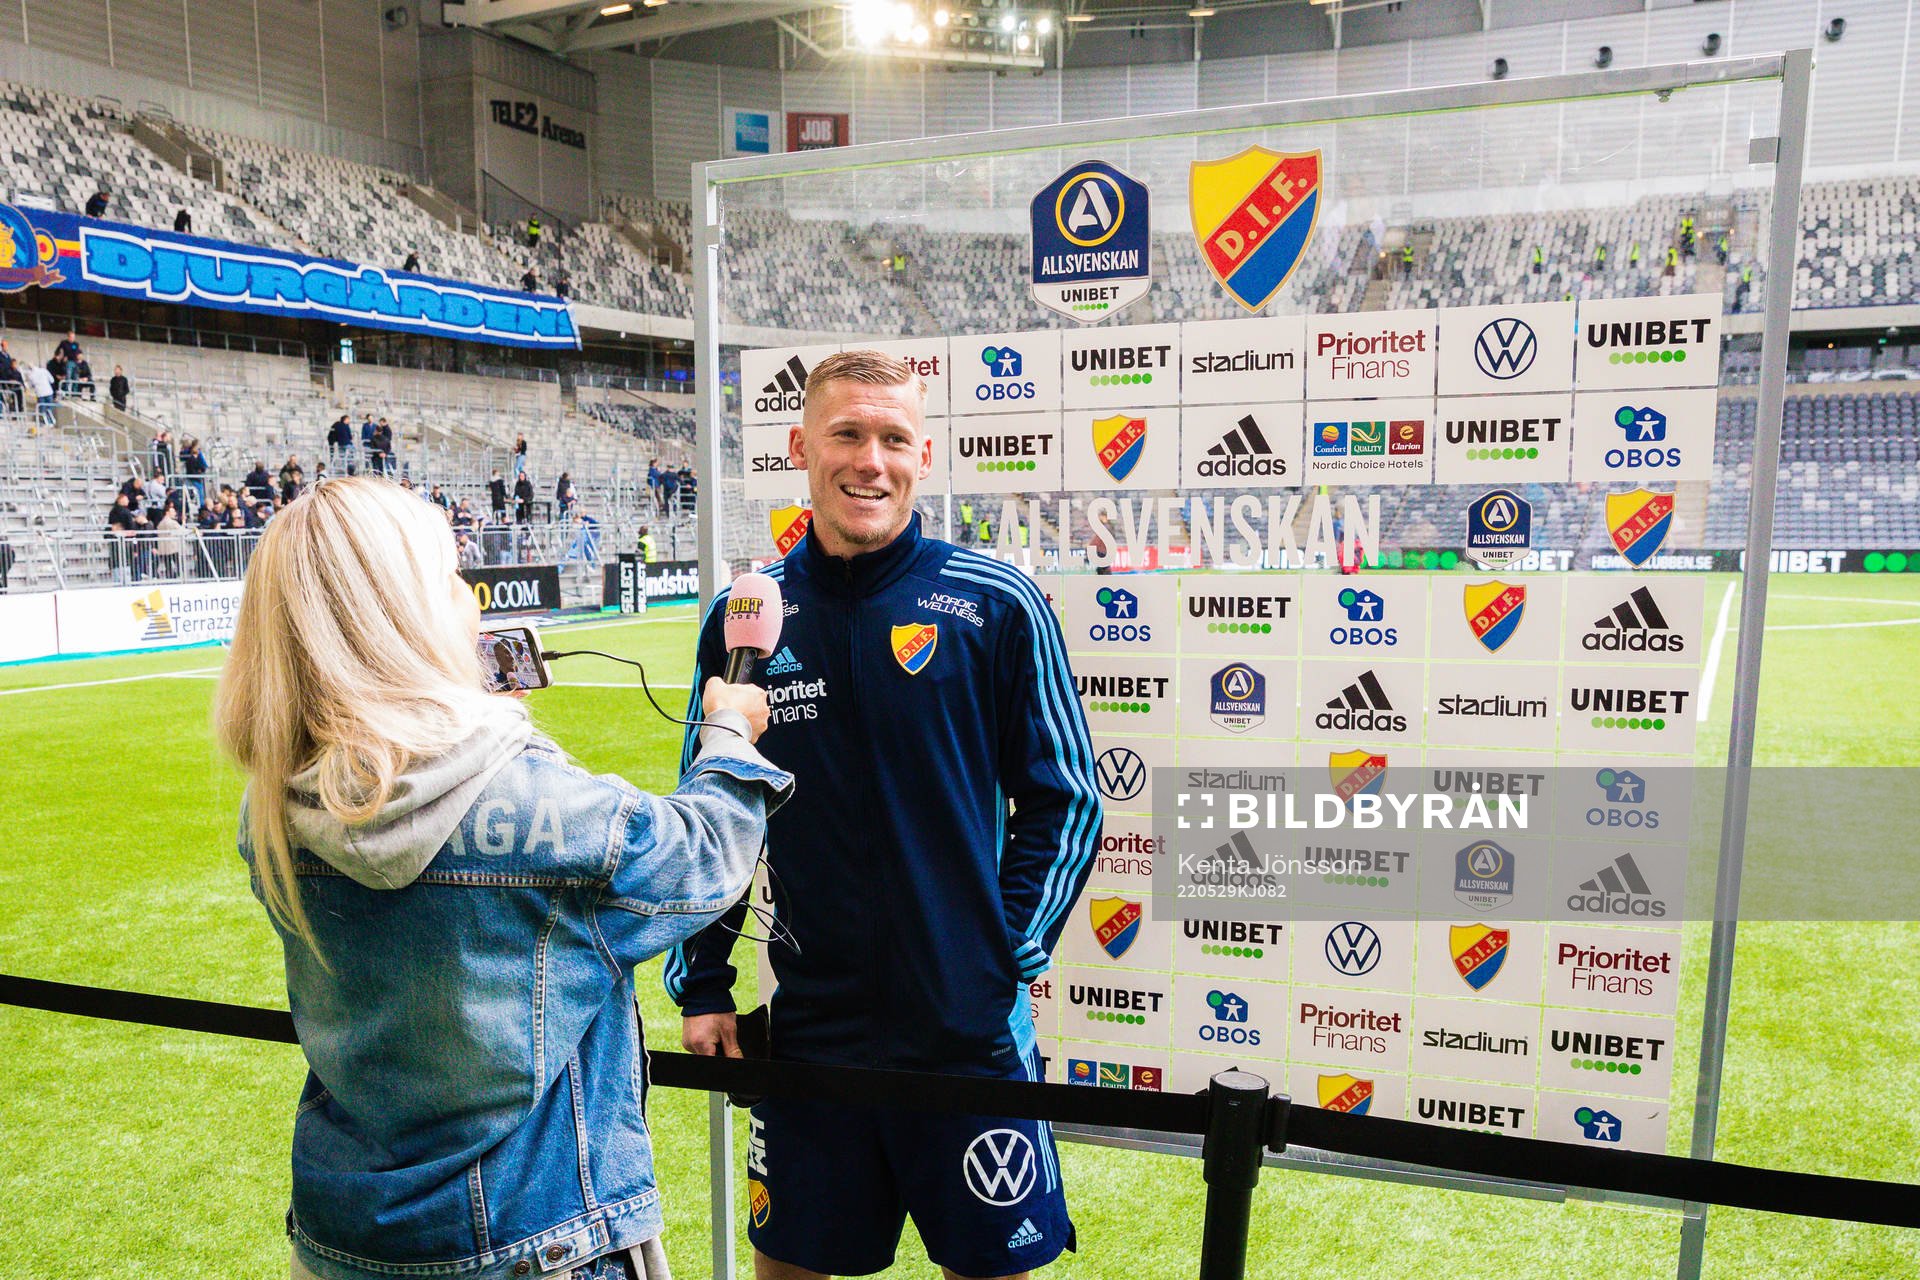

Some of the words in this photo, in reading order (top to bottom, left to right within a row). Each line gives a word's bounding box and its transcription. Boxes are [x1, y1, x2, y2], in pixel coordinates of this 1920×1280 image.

[490, 99, 539, 135] TELE2
[541, 115, 586, 150] Arena
[801, 120, 832, 141] JOB
[1215, 171, 1308, 261] D.I.F.
[1041, 250, 1139, 276] ALLSVENSKAN
[1061, 286, 1119, 303] UNIBET
[1317, 329, 1426, 357] Prioritet
[1587, 318, 1711, 348] UNIBET
[1071, 345, 1171, 371] UNIBET
[1192, 349, 1294, 374] stadium
[1332, 356, 1410, 380] Finans
[755, 390, 806, 413] adid
[975, 382, 1036, 401] OBOS
[1103, 422, 1142, 459] D.I.F.
[1445, 418, 1561, 444] UNIBET
[959, 434, 1053, 458] UNIBET
[1313, 444, 1347, 454] Comfort
[1353, 445, 1382, 453] QUALITY
[1391, 442, 1421, 451] Clarion
[1604, 447, 1681, 468] OBOS
[1197, 454, 1287, 477] adidas
[1312, 461, 1347, 470] Nordic
[1349, 460, 1385, 469] Choice
[1387, 459, 1424, 469] Hotels
[996, 494, 1381, 567] ALLSVENSKAN
[1618, 500, 1669, 544] D.I.F.
[1472, 534, 1525, 545] ALLSVENSKAN
[1482, 551, 1514, 559] UNIBET
[620, 561, 634, 614] SELECT
[169, 594, 240, 615] Haninge
[726, 597, 764, 616] PORT
[917, 598, 984, 628] WELLNESS
[930, 592, 978, 613] NORDIC
[1188, 596, 1292, 619] UNIBET
[1475, 590, 1520, 630] D.I.F.
[171, 615, 238, 633] Terrazz
[1089, 624, 1151, 642] OBOS
[1329, 627, 1398, 647] OBOS
[1582, 628, 1685, 652] adidas
[766, 662, 804, 676] adidas
[766, 678, 827, 704] ioritet
[1075, 675, 1169, 699] UNIBET
[1215, 701, 1261, 713] ALLSVENSKAN
[1438, 694, 1547, 718] stadium
[1571, 688, 1689, 714] UNIBET
[768, 703, 818, 724] inans
[1315, 709, 1407, 732] adidas
[1188, 769, 1286, 791] stadium
[1434, 770, 1545, 797] UNIBET
[1585, 807, 1659, 829] OBOS
[1099, 832, 1166, 855] oritet
[1097, 852, 1152, 876] inans
[1305, 846, 1410, 874] UNIBET
[1459, 878, 1509, 891] ALLSVENSKAN
[1468, 895, 1498, 904] UNIBET
[1567, 892, 1666, 917] adidas
[1101, 909, 1138, 941] D.I.F.
[1184, 918, 1283, 945] UNIBET
[1460, 935, 1504, 970] D.I.F.
[1558, 942, 1671, 974] Prioritet
[1571, 967, 1653, 996] Finans
[1069, 984, 1163, 1012] UNIBET
[1300, 1002, 1401, 1033] Prioritet
[1199, 1024, 1261, 1046] OBOS
[1313, 1025, 1386, 1053] Finans
[1423, 1028, 1528, 1056] stadium
[1551, 1029, 1665, 1061] UNIBET
[1418, 1098, 1525, 1129] UNIBET
[1008, 1231, 1044, 1249] adidas
